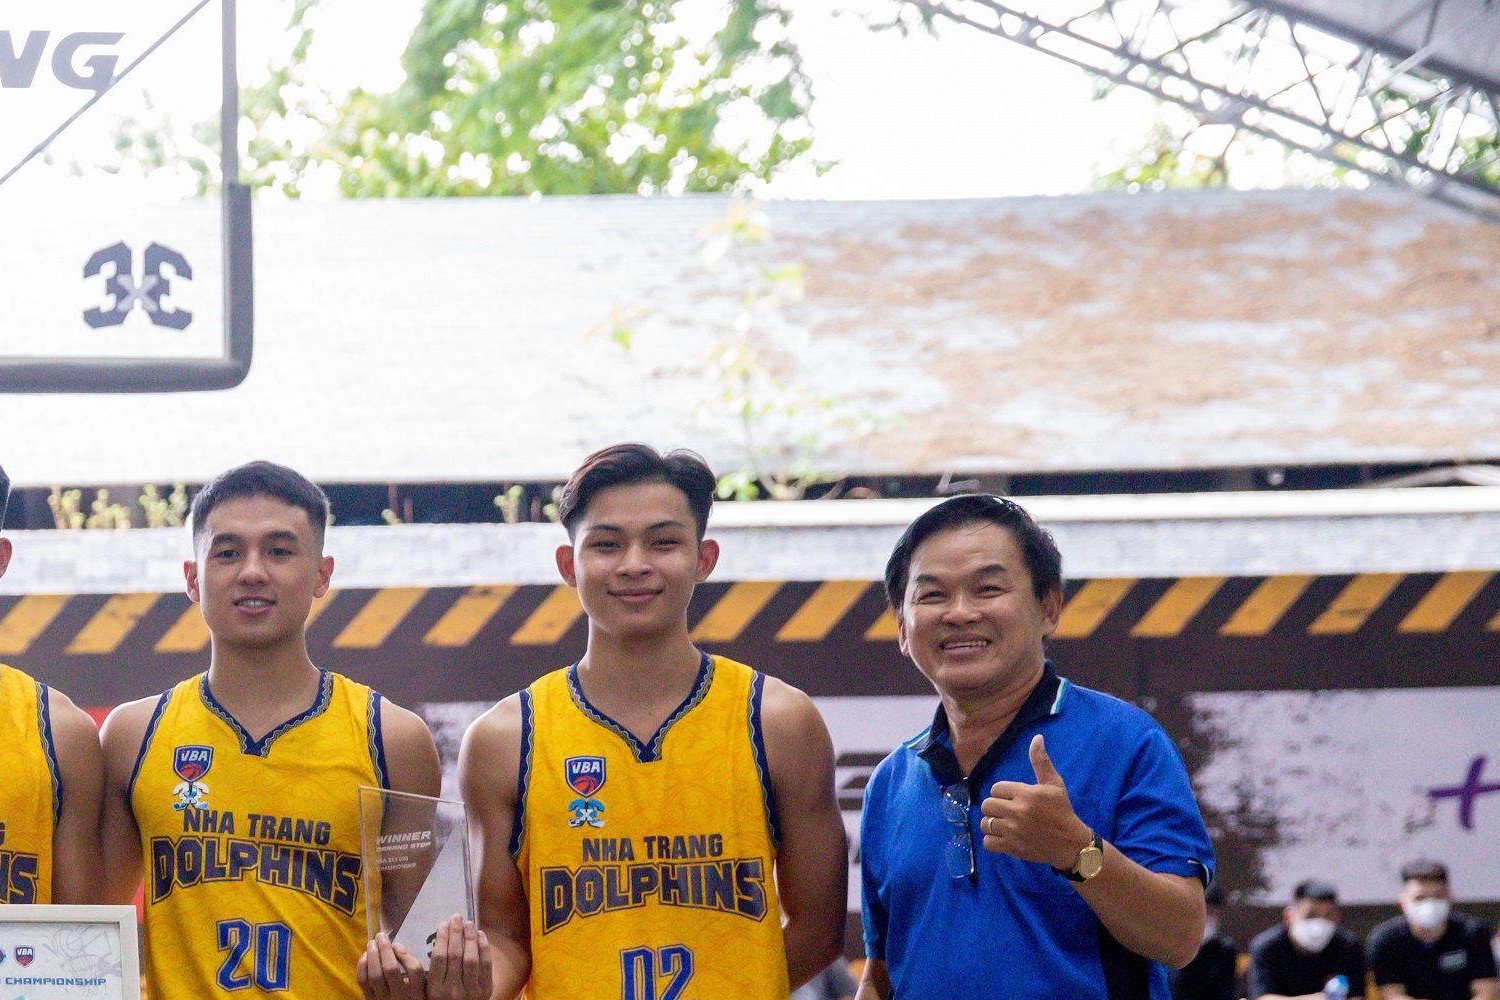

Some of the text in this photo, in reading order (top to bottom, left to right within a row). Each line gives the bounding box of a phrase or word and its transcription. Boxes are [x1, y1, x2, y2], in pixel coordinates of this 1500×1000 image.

[180, 750, 208, 762] VBA
[571, 761, 601, 774] VBA
[183, 809, 331, 846] NHA TRANG
[376, 831, 431, 845] WINNER
[582, 833, 723, 862] NHA TRANG
[151, 836, 362, 918] DOLPHINS
[541, 857, 768, 936] DOLPHINS
[216, 918, 293, 993] 20
[5, 977, 107, 986] CHAMPIONSHIP
